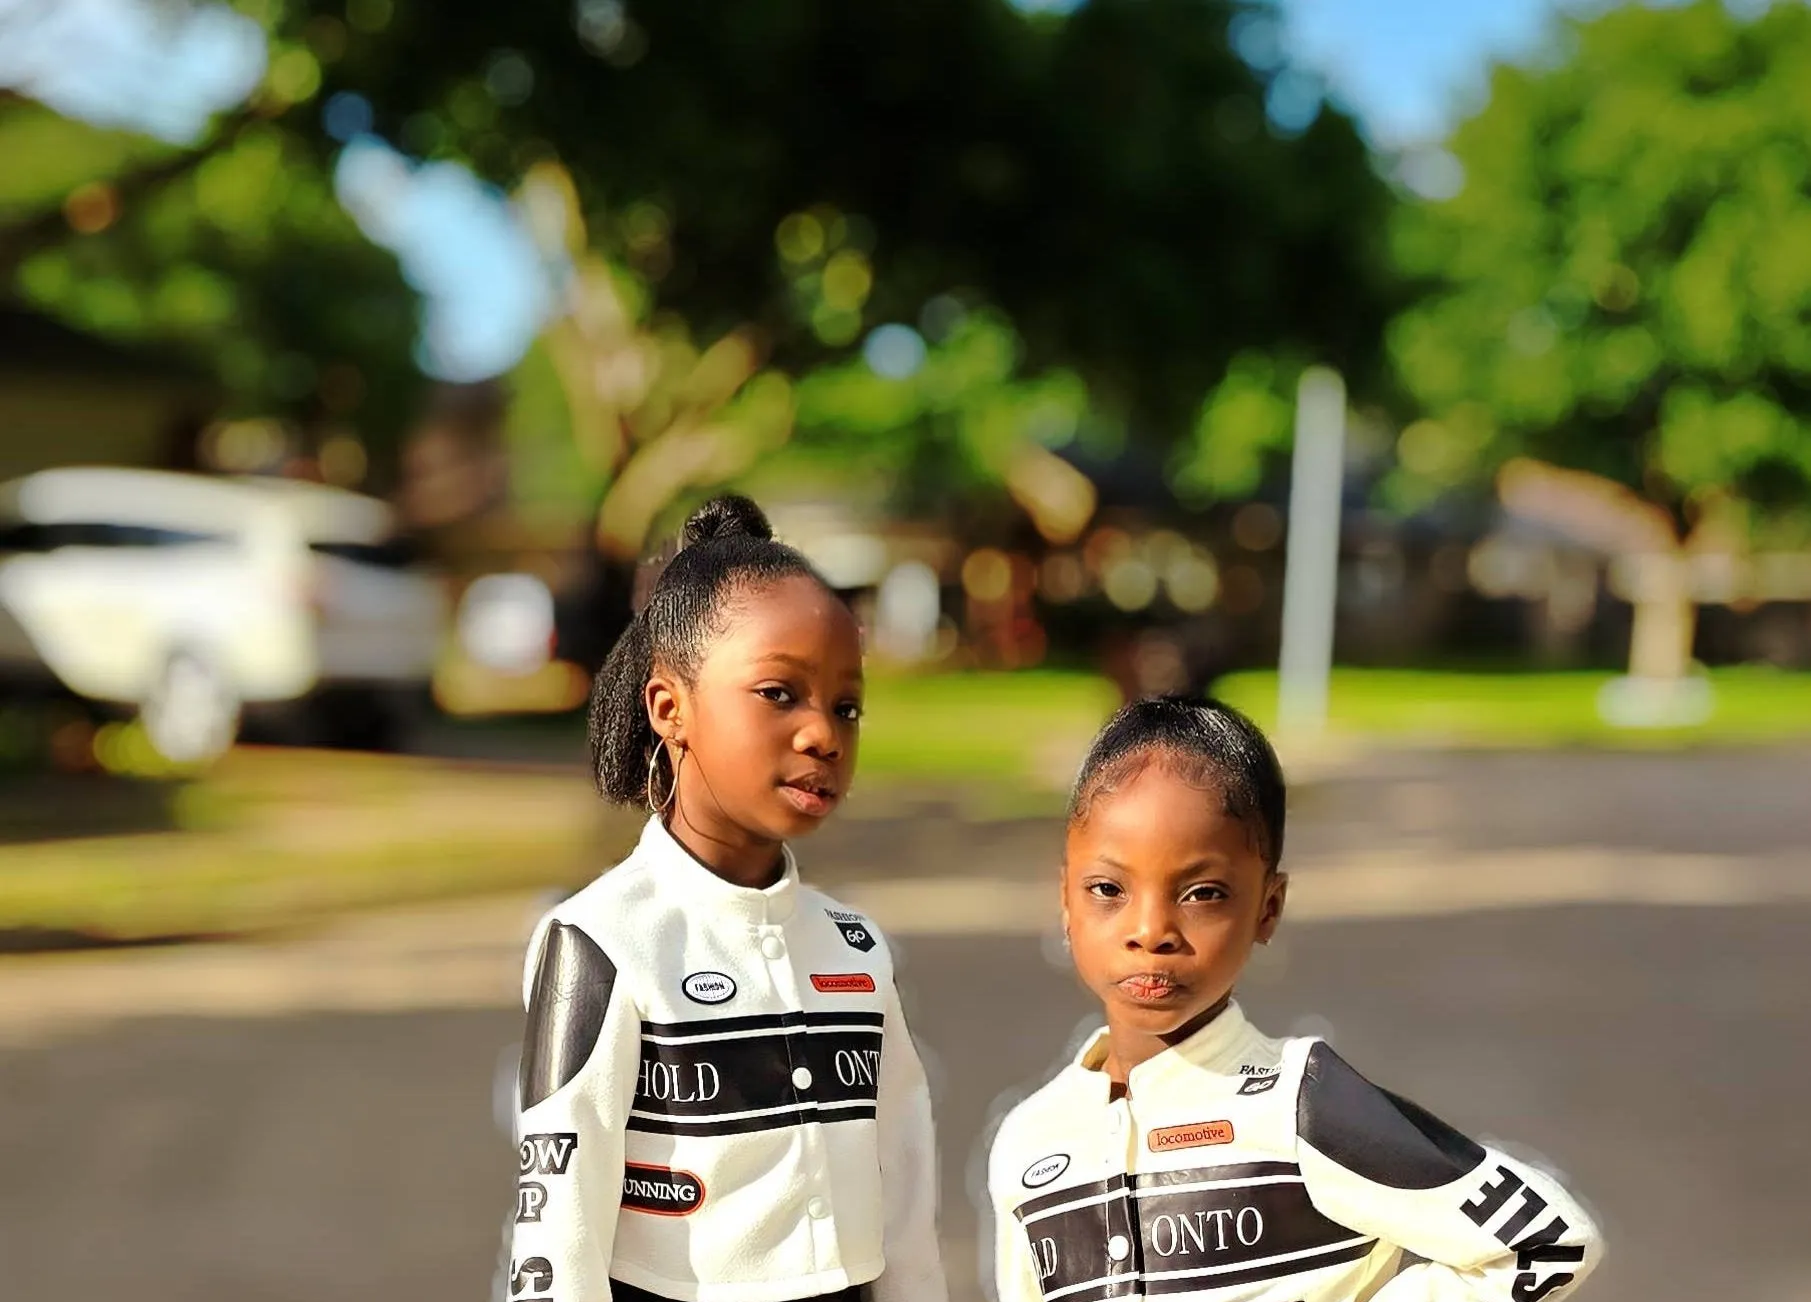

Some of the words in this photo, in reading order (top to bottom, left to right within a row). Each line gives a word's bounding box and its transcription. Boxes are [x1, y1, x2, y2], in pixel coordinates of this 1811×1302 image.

[835, 1050, 880, 1087] ONT
[519, 1133, 578, 1175] OW
[1156, 1126, 1225, 1146] locomotive
[622, 1176, 697, 1203] UNNING
[1151, 1206, 1264, 1258] ONTO
